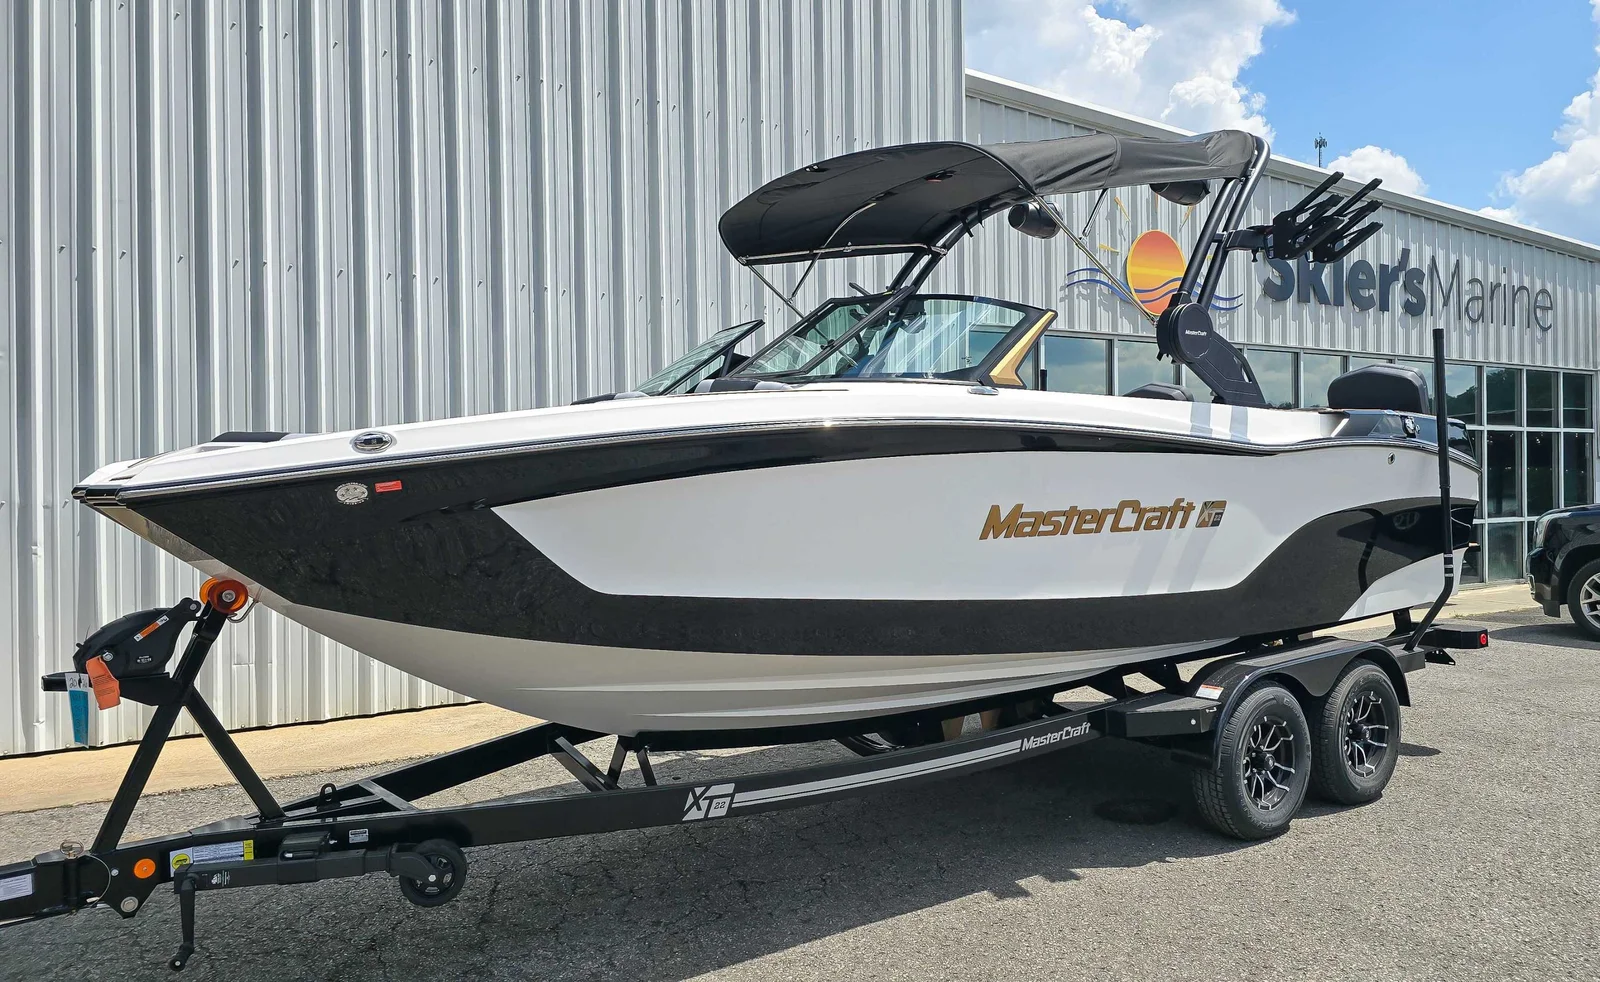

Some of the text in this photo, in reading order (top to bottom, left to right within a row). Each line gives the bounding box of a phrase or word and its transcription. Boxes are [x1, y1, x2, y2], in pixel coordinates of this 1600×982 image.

[1428, 254, 1554, 331] Marine
[979, 497, 1196, 540] MasterCraft
[1021, 721, 1092, 752] MasterCraft
